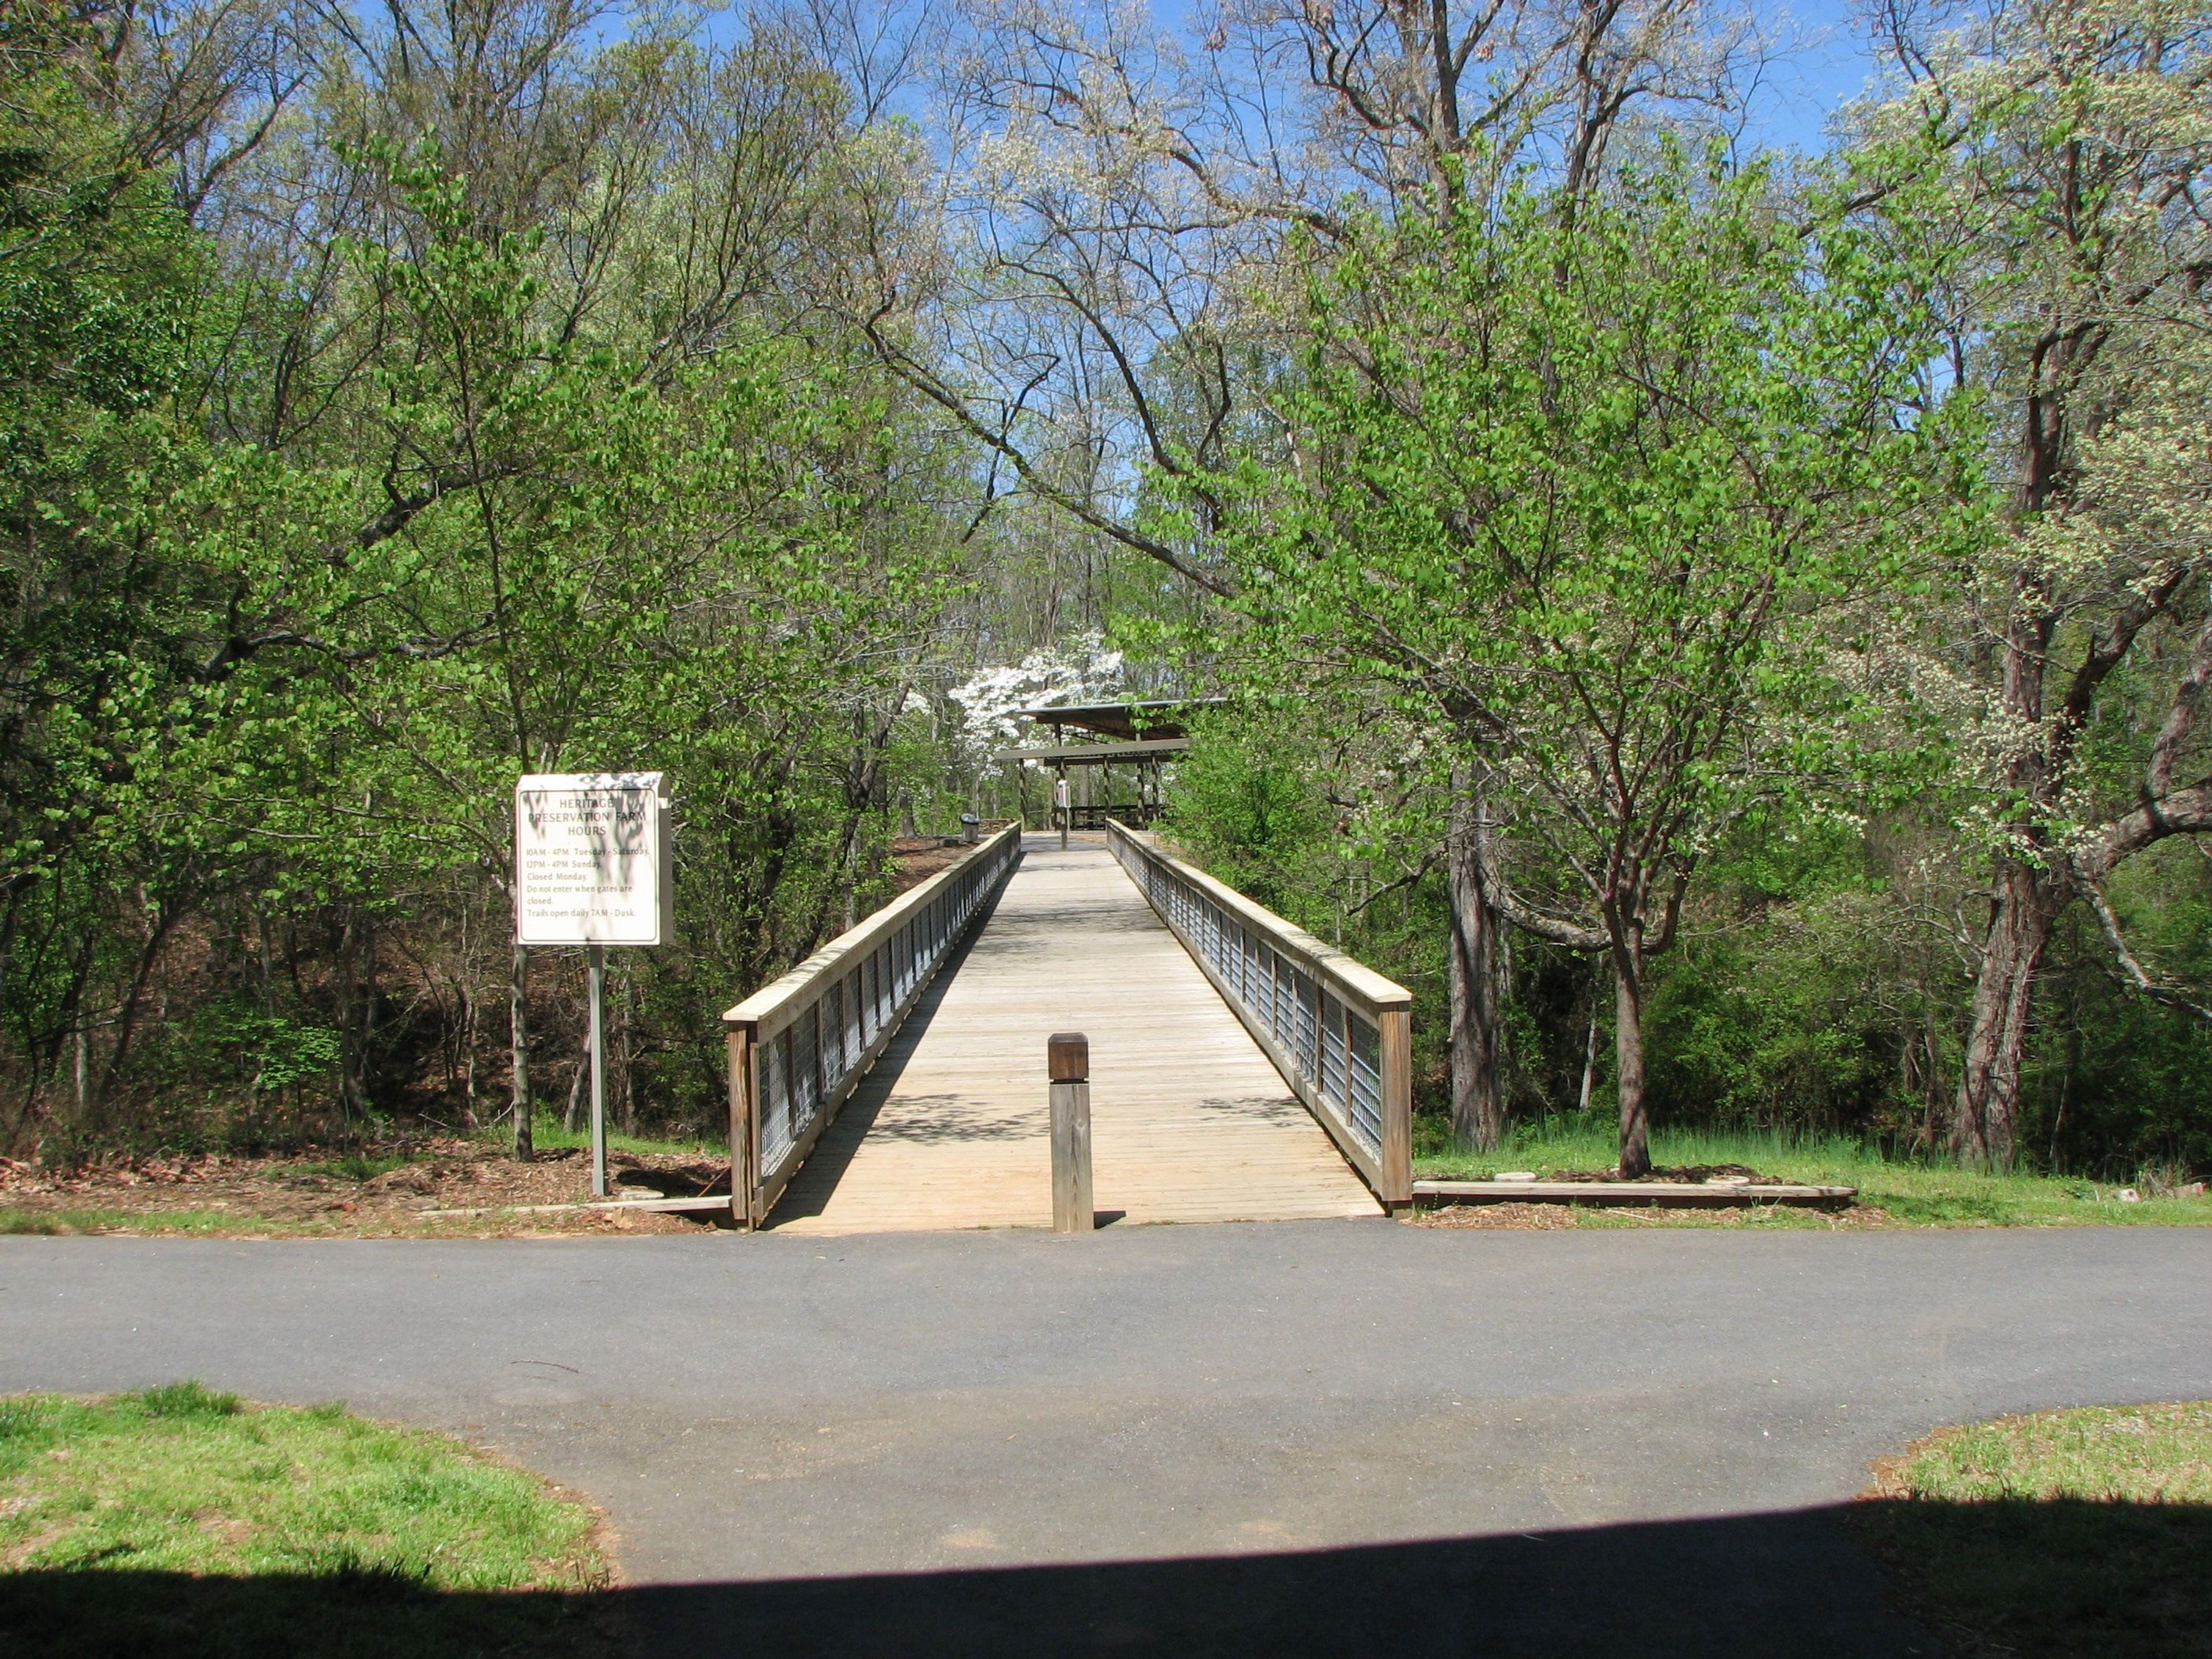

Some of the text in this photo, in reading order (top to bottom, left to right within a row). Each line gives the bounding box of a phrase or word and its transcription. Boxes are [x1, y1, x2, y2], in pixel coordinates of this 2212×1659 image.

[560, 798, 614, 809] HERITAGE
[529, 812, 646, 823] PRESERVATION FARM
[568, 826, 606, 836] HOURS
[575, 848, 606, 857] Tuesday
[597, 886, 618, 894] gates
[571, 909, 589, 918] daily
